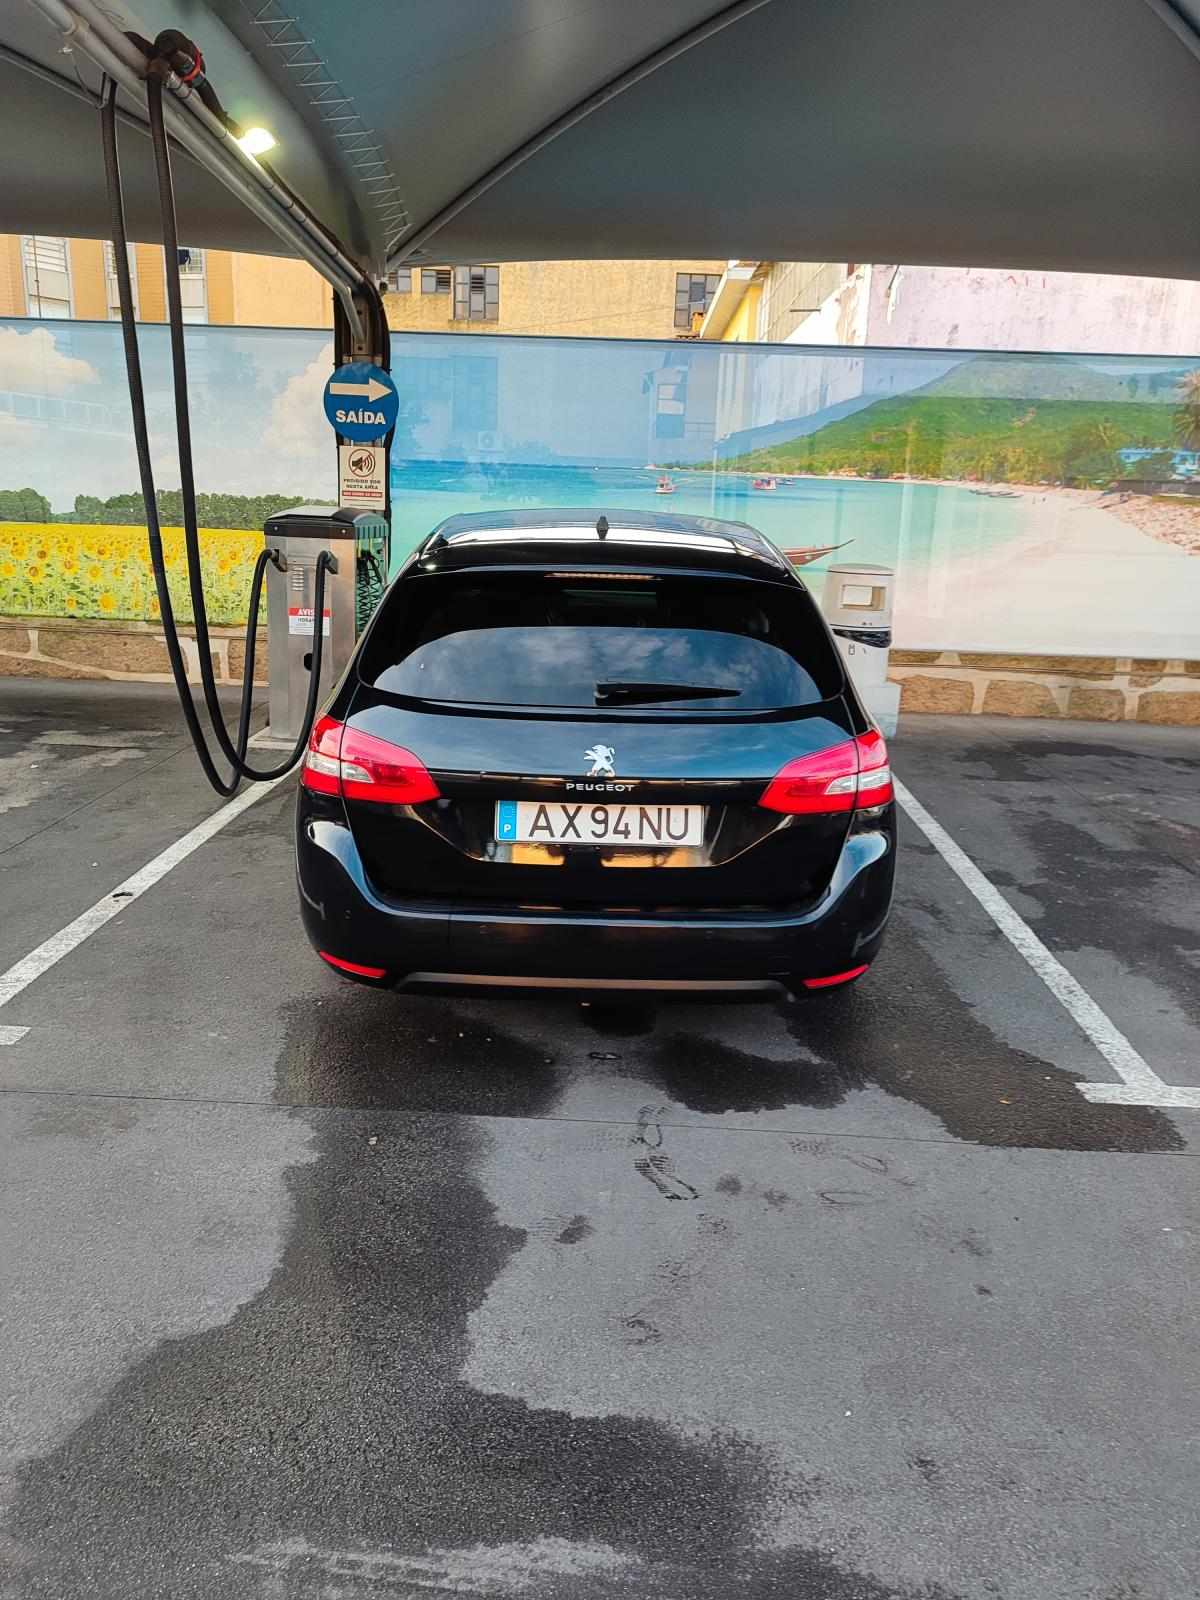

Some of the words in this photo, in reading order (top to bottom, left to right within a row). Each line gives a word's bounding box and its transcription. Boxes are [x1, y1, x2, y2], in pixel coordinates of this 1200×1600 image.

[335, 408, 386, 425] SAÍDA
[297, 607, 317, 616] AVIS
[565, 783, 635, 792] PEUGEOT
[503, 823, 512, 833] P
